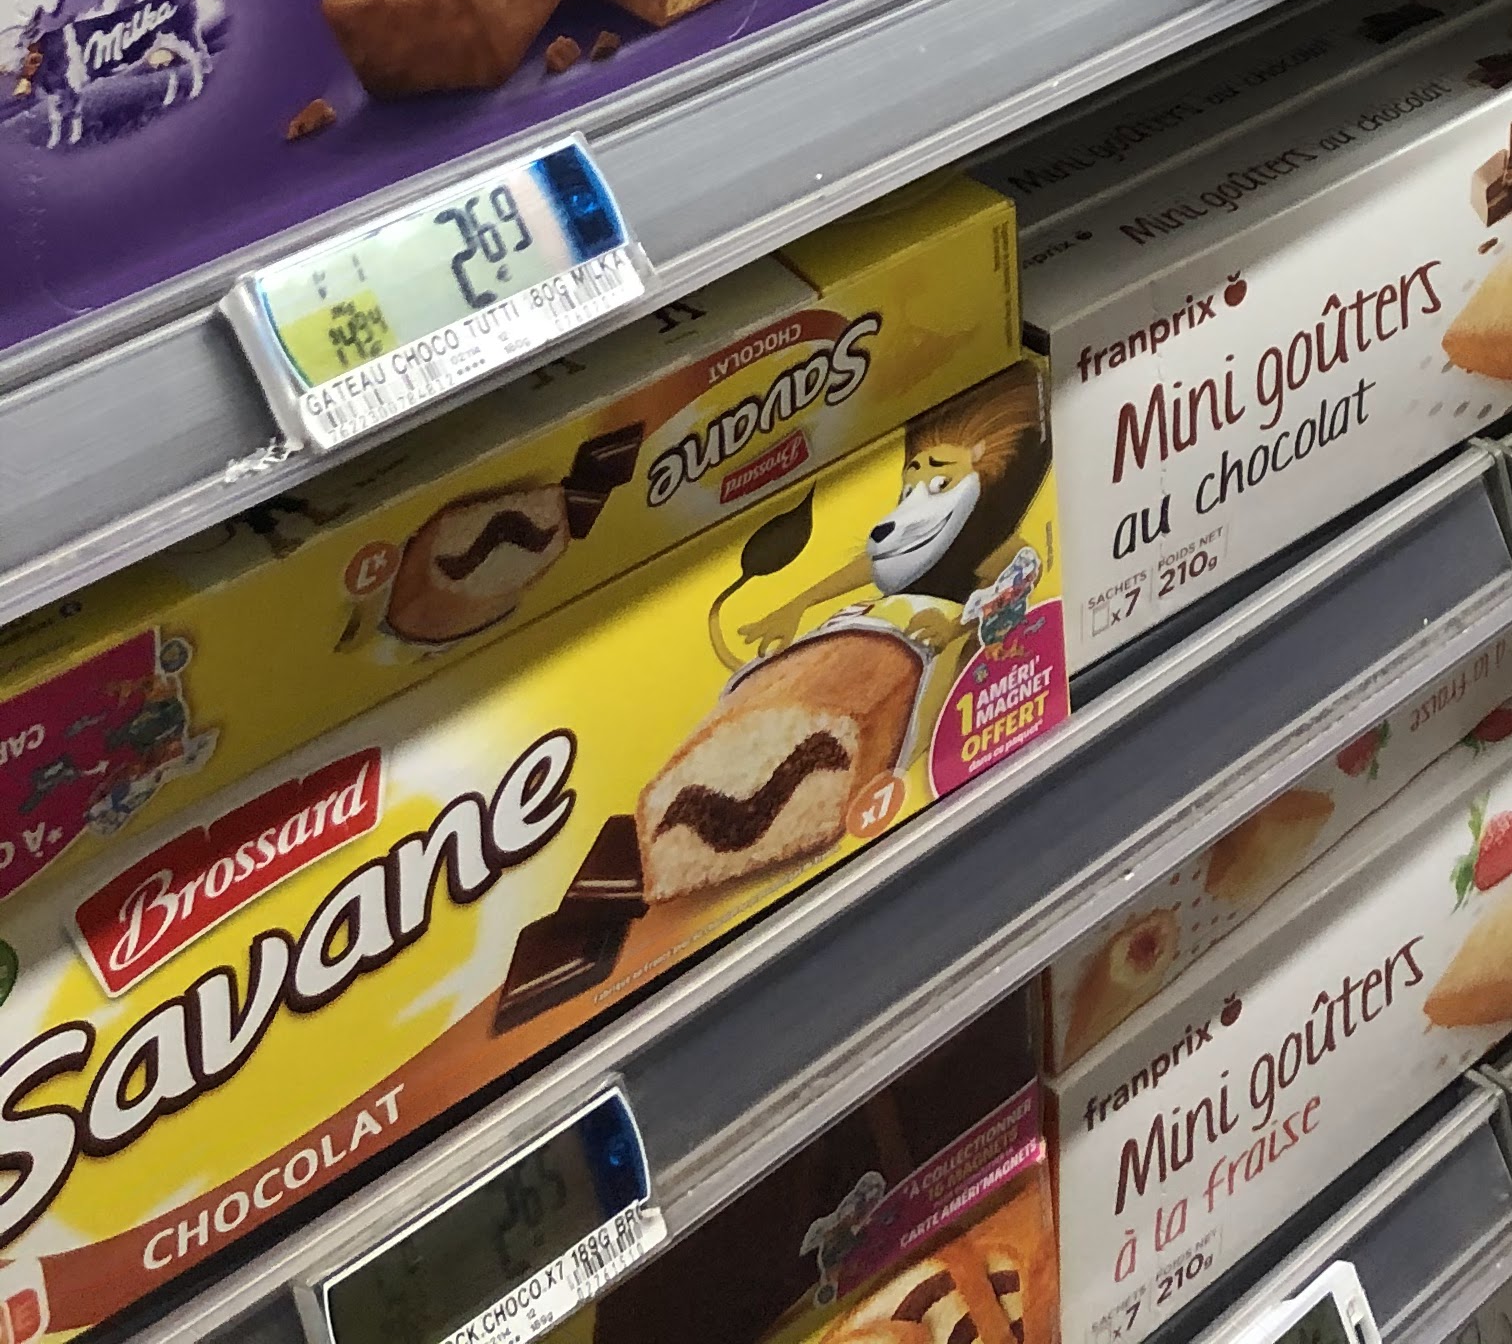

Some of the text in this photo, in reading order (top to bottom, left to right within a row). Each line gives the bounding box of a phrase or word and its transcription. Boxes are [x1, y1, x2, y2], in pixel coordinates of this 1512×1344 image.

[84, 0, 178, 72] Milka
[1121, 198, 1194, 247] Mini
[305, 252, 628, 417] GATEAU CHOCO TUTTI MILKA
[708, 323, 802, 385] CHOCOLAT
[1077, 291, 1216, 384] franprix
[1112, 259, 1447, 484] Mini goûters
[646, 311, 883, 508] Savane
[1112, 379, 1377, 561] au chocolat
[1156, 525, 1225, 571] POIDS NET
[1157, 551, 1220, 602] 210g
[1087, 569, 1149, 611] SACHETS
[956, 690, 974, 737] 1
[960, 690, 1050, 763] OFFERT
[975, 665, 1053, 729] MAGNET
[968, 751, 993, 773] dans
[855, 784, 896, 829] x7
[117, 773, 368, 963] Brossard
[0, 726, 578, 1250] Savane
[1082, 1021, 1215, 1132] franprix
[1114, 933, 1429, 1217] Mini goûters
[141, 1080, 406, 1273] CHOCOLAT
[1114, 1095, 1323, 1284] à la fraise
[899, 1219, 940, 1249] CARTE
